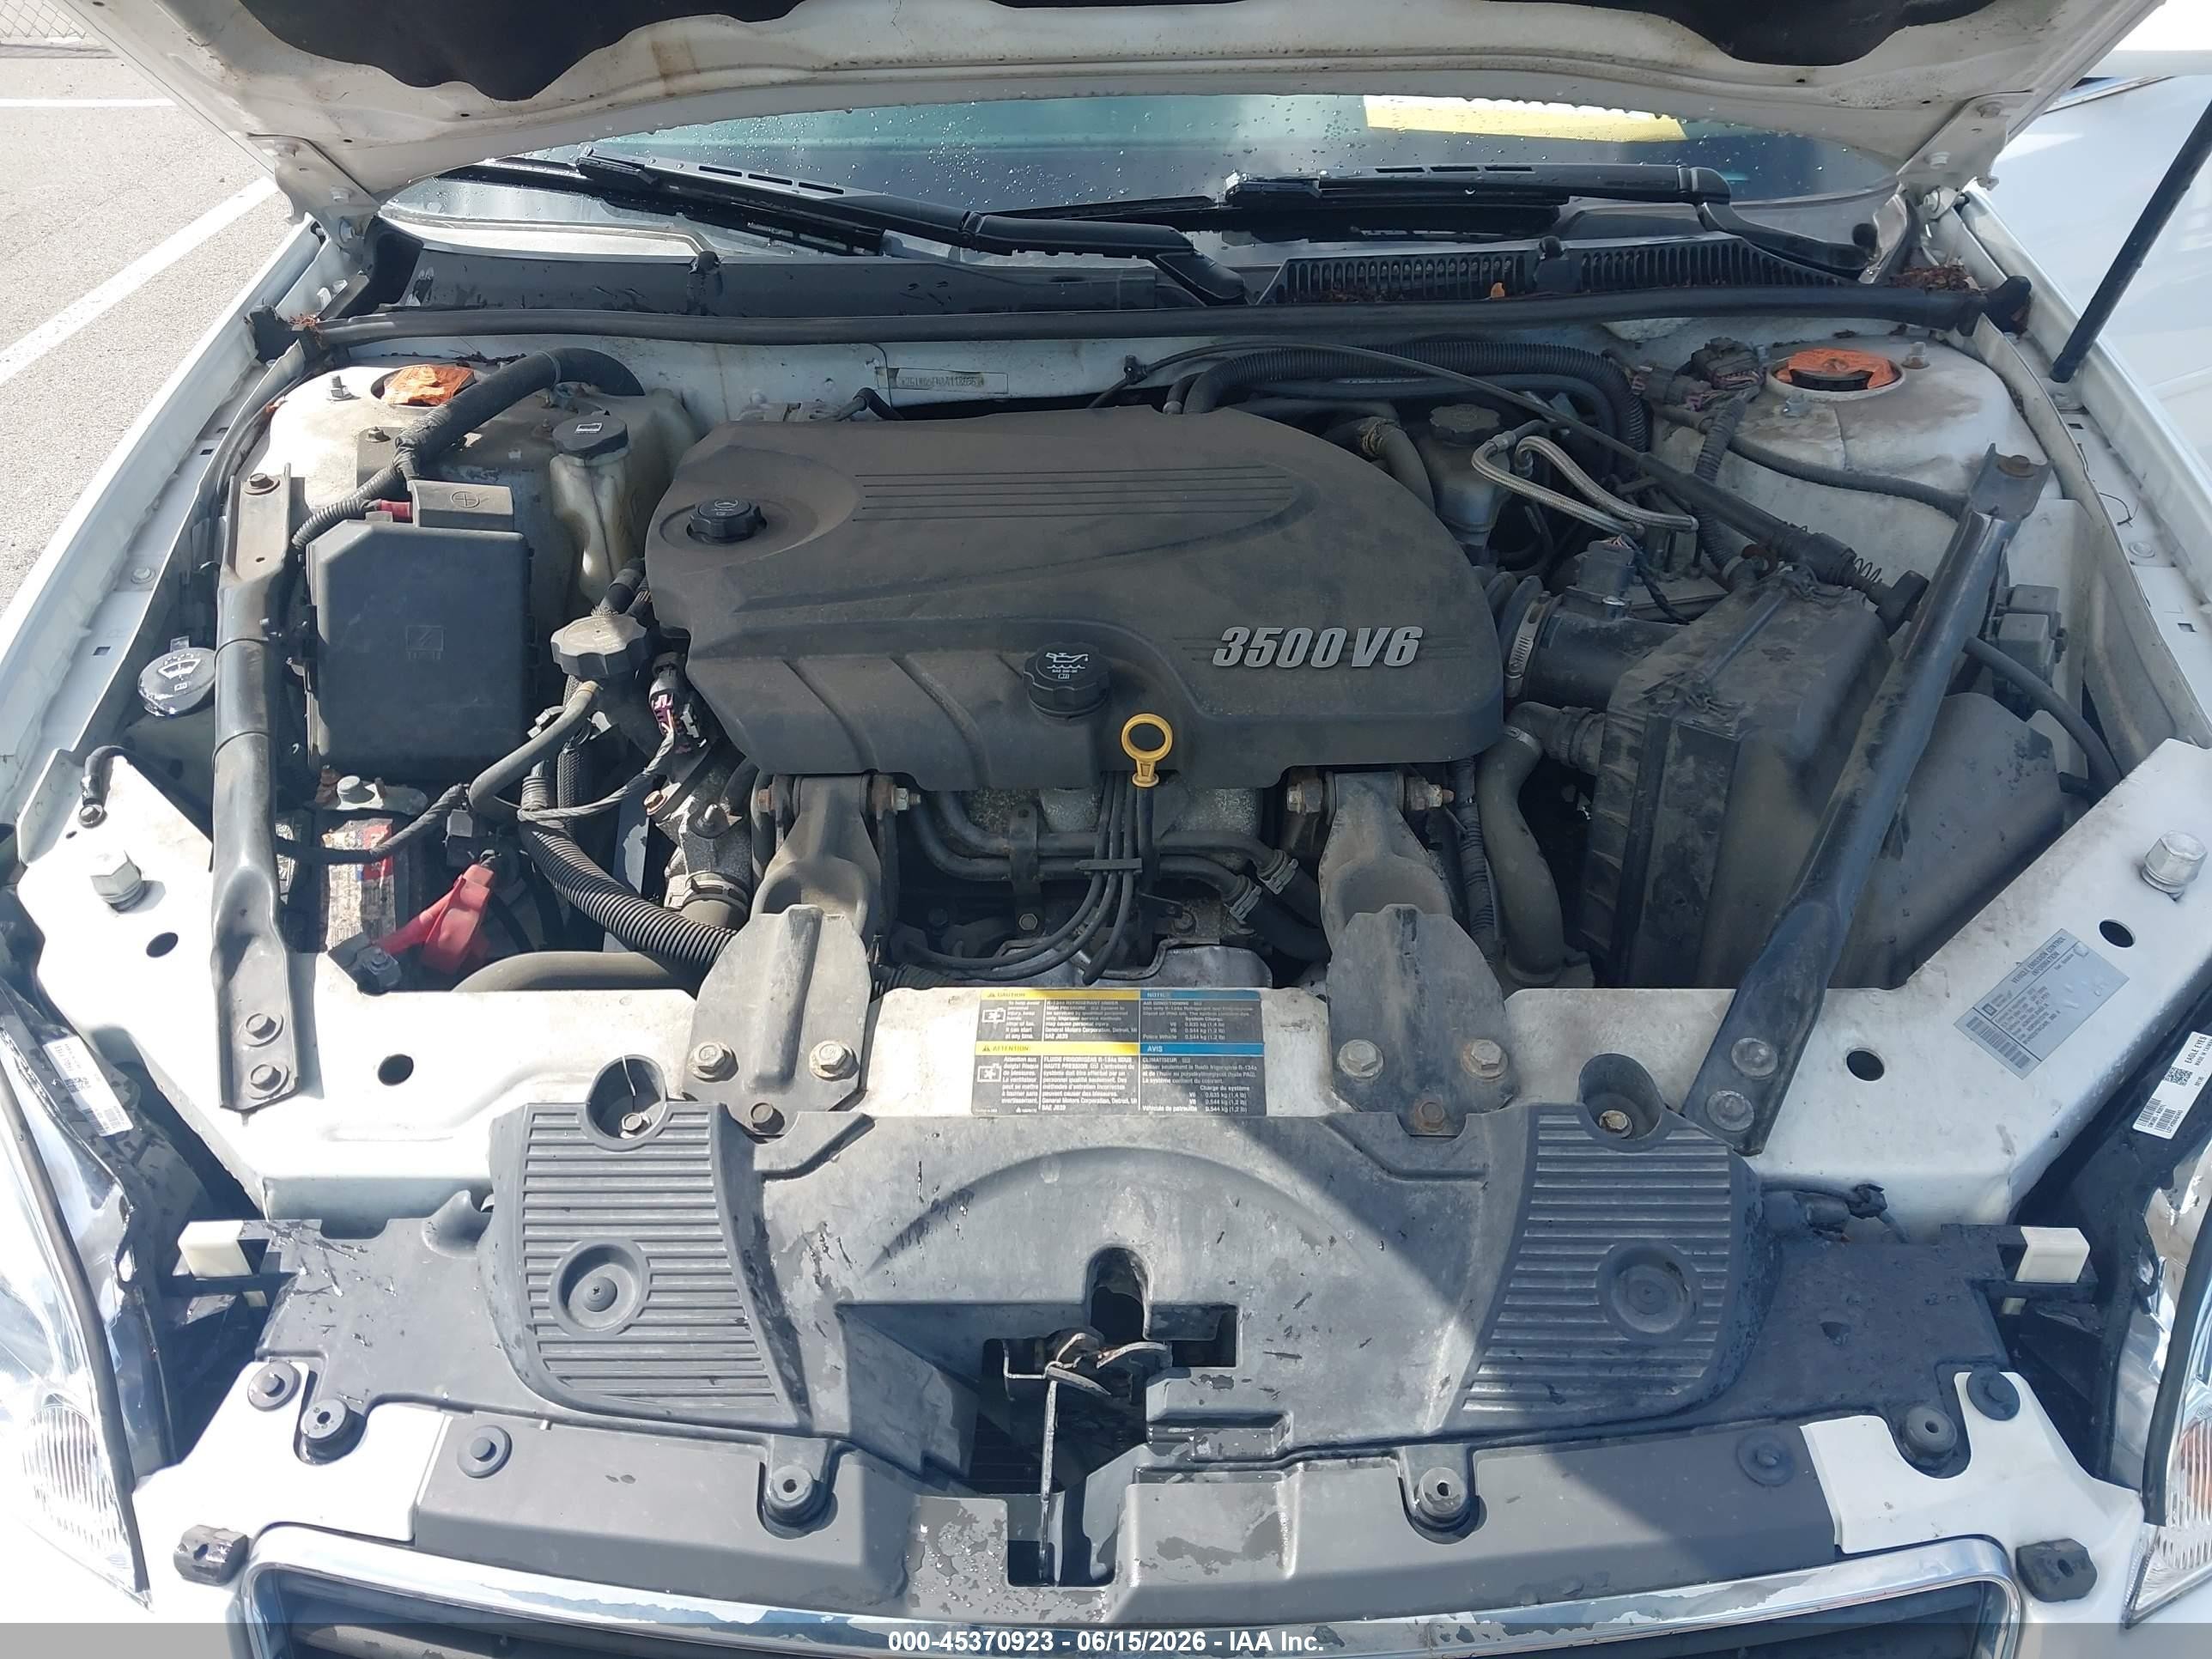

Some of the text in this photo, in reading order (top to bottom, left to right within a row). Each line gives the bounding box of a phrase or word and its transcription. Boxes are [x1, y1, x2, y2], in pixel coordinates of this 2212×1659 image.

[1212, 626, 1424, 668] 3500 V6
[2185, 1048, 2199, 1064] EAGLE
[2194, 1036, 2208, 1048] EYES
